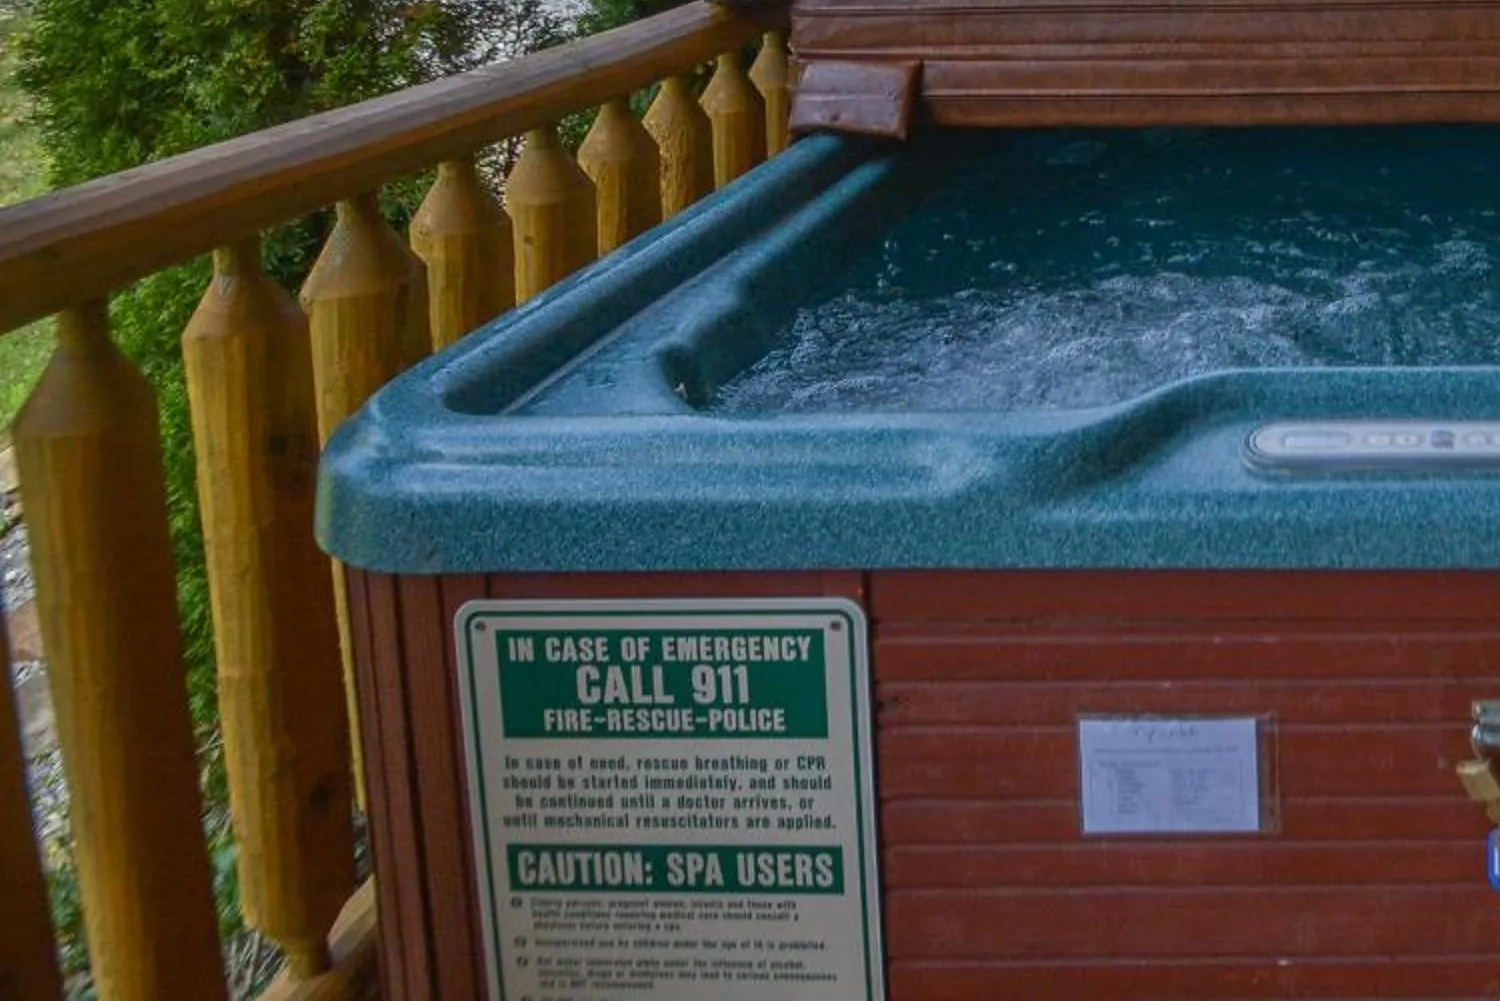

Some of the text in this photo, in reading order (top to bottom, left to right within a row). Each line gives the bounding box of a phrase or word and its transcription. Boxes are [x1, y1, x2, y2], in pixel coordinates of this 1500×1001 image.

[508, 636, 811, 662] IN CASE OF EMERGENCY
[576, 665, 750, 705] CALL 911
[505, 756, 519, 770] In
[526, 758, 561, 770] case
[568, 756, 583, 770] of
[637, 758, 688, 771] rescue
[695, 756, 767, 772] breathing
[775, 758, 790, 770] or
[797, 756, 825, 770] CPR
[503, 775, 551, 789] should
[557, 775, 575, 789] be
[582, 775, 638, 789] started
[750, 775, 776, 789] and
[783, 775, 832, 790] should
[515, 794, 533, 808] be
[540, 794, 613, 808] continued
[621, 794, 655, 808] until
[661, 797, 670, 808] a
[677, 795, 725, 809] doctor
[799, 798, 814, 809] or
[503, 813, 837, 831] until mechanical resuscitators are applied.
[517, 851, 835, 888] CAUTION: SPA USERS
